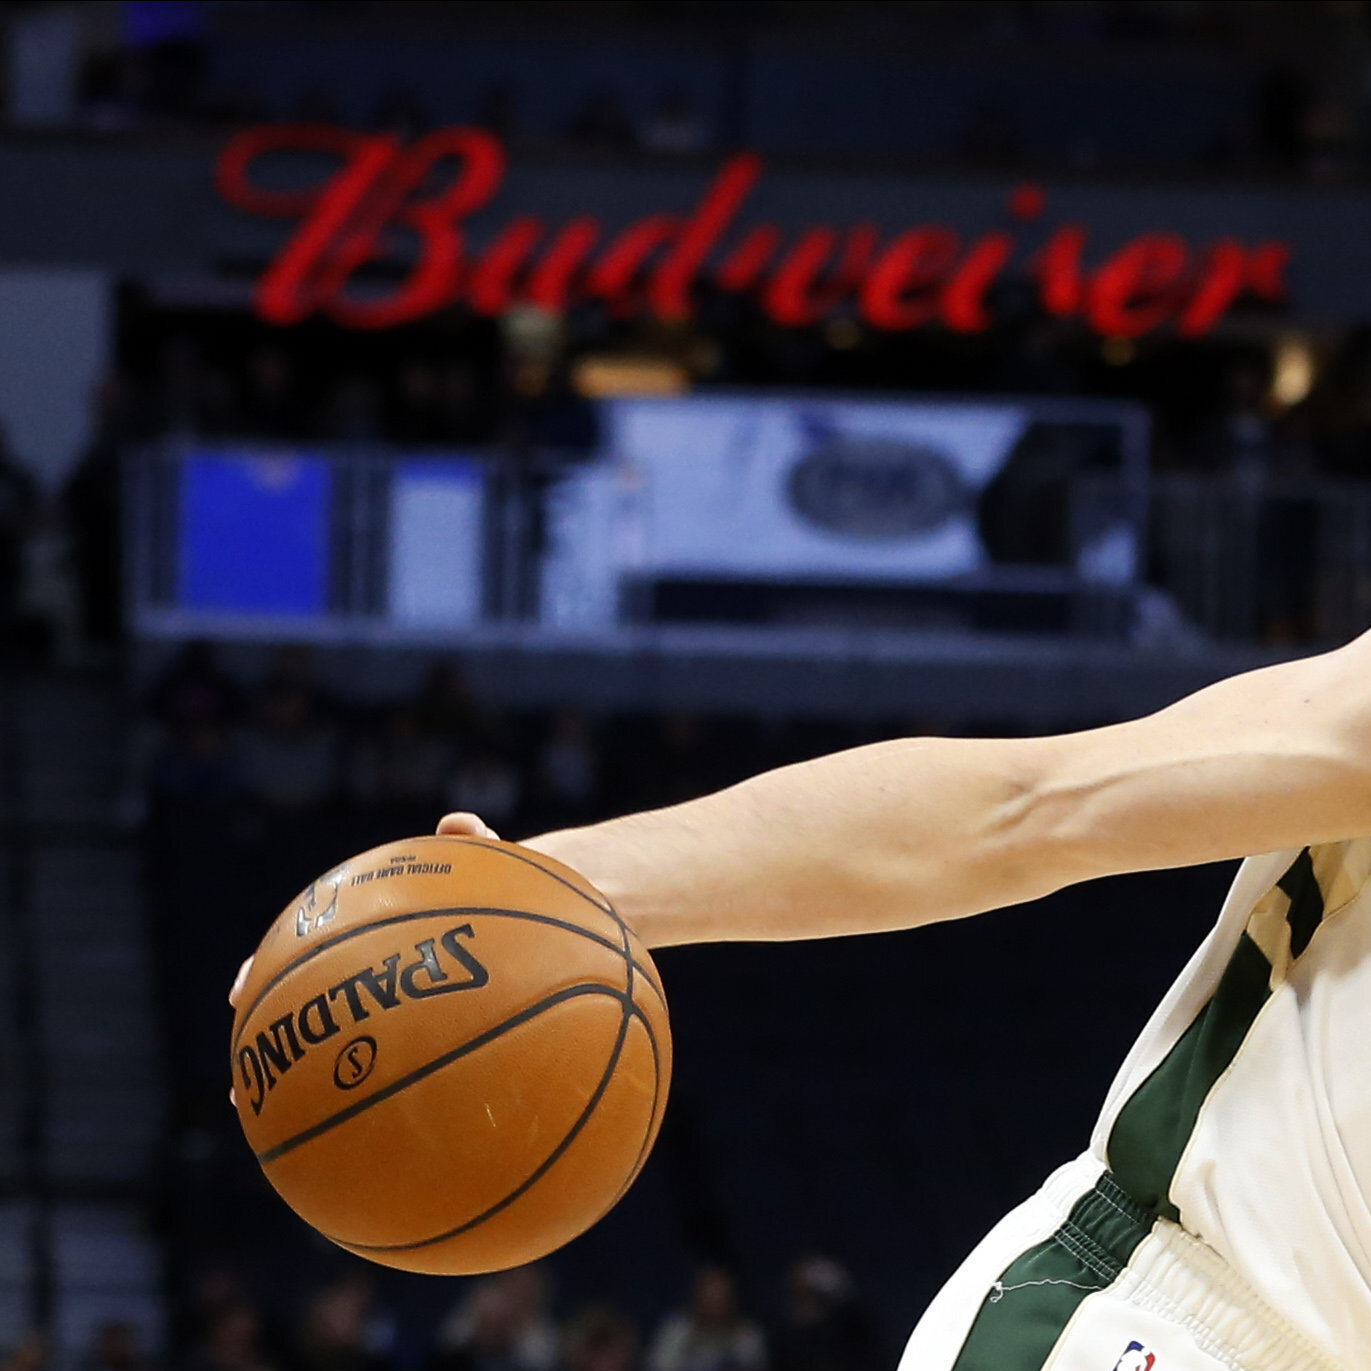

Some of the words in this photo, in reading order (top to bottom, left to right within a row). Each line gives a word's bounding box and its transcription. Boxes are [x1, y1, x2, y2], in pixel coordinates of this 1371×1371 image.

[216, 125, 1291, 337] Budweiser
[407, 864, 452, 874] OFFICIAL
[238, 923, 489, 1117] SPALDING
